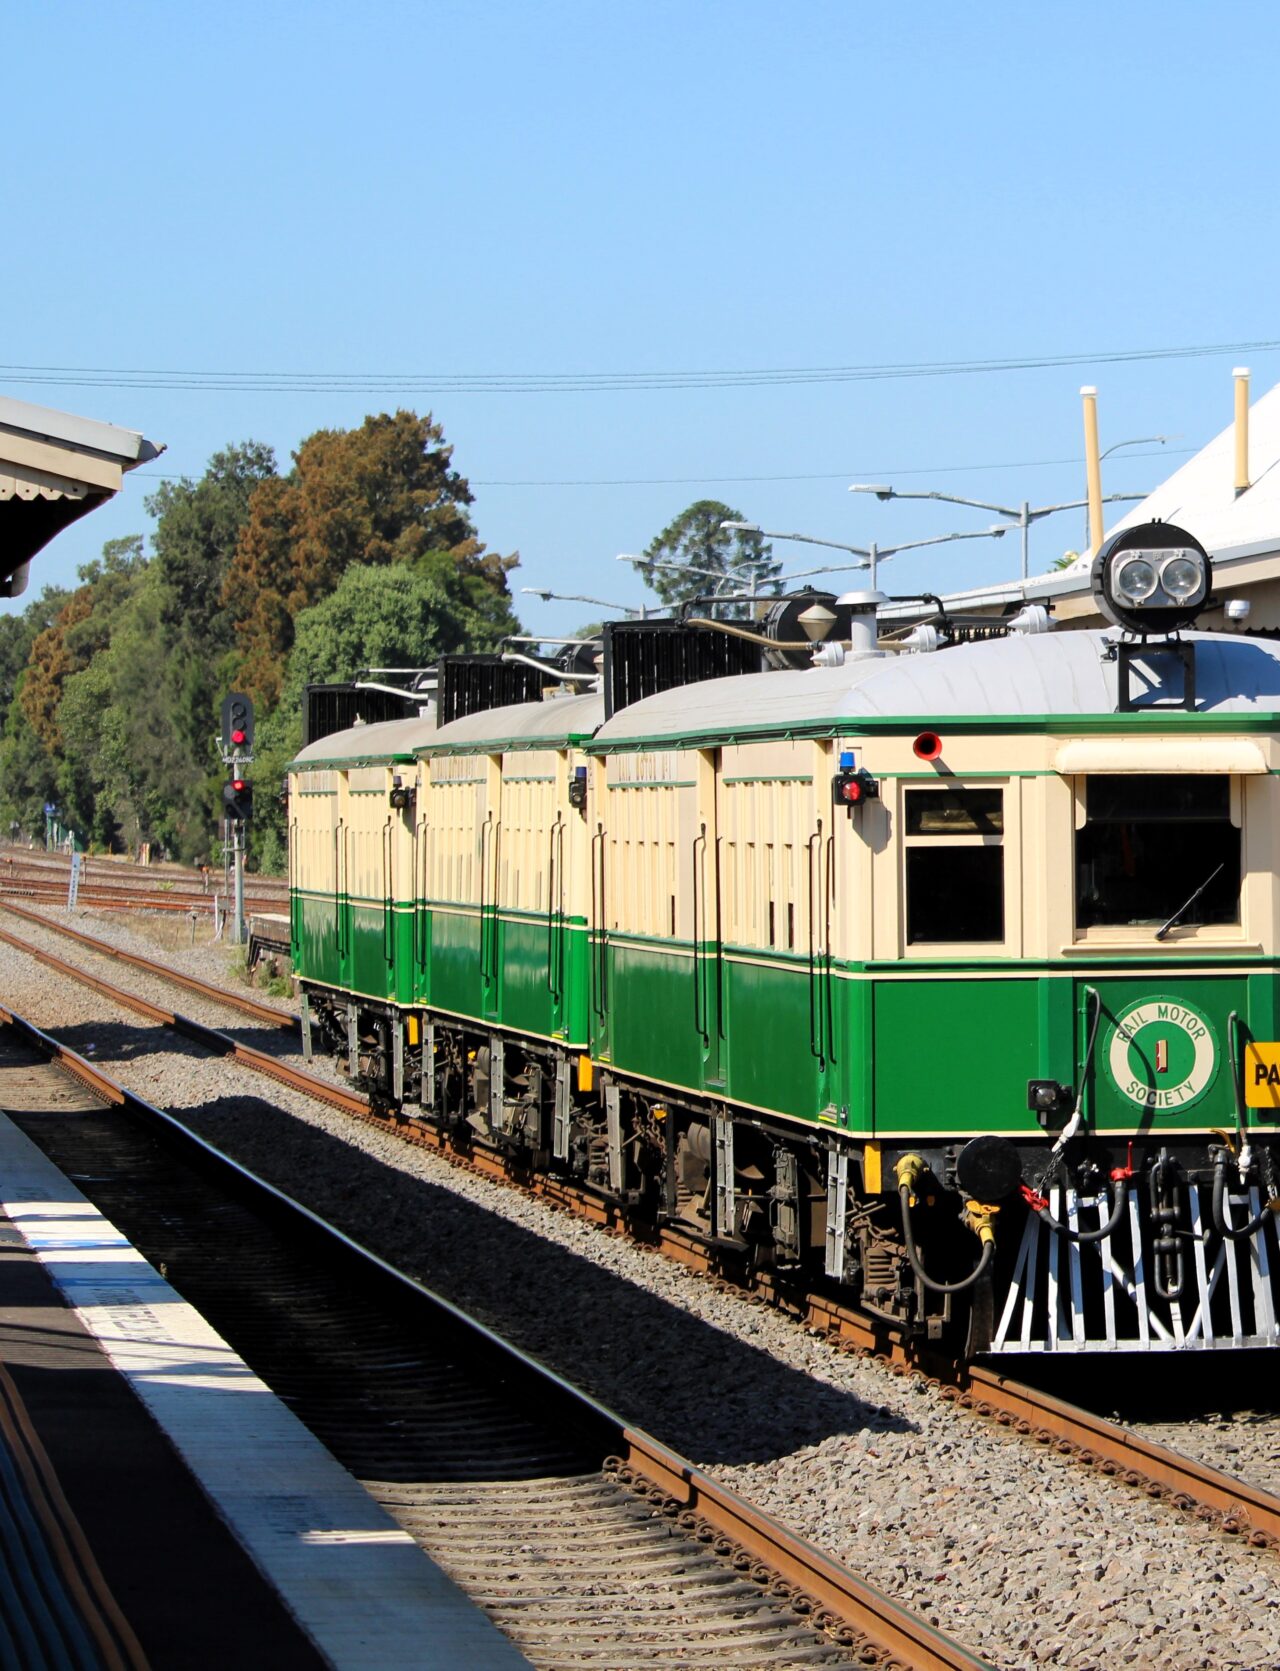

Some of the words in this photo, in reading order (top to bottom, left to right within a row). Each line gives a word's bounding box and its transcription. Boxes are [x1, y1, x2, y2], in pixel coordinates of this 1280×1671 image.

[1117, 1012, 1148, 1043] RAIL
[1158, 1005, 1206, 1040] MOTOR
[1127, 1081, 1196, 1106] SOCIETY
